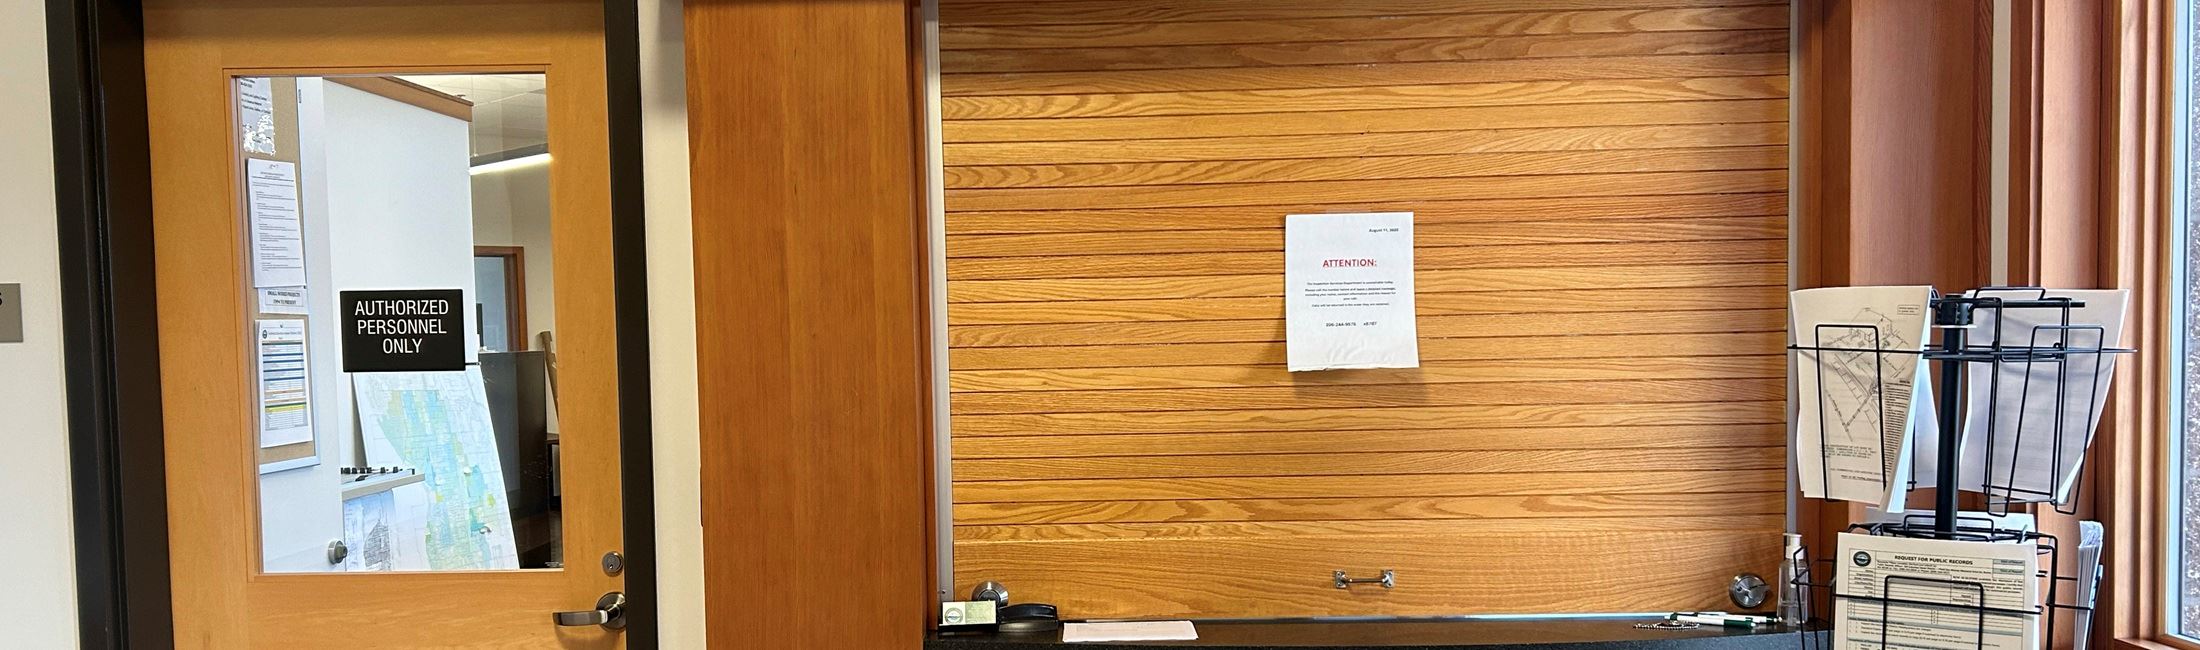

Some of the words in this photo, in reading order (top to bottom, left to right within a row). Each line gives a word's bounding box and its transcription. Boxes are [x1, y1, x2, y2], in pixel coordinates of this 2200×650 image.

[1322, 258, 1377, 268] ATTENTION:
[354, 299, 449, 316] AUTHORIZED
[357, 319, 447, 335] PERSONNEL
[382, 338, 423, 354] ONLY
